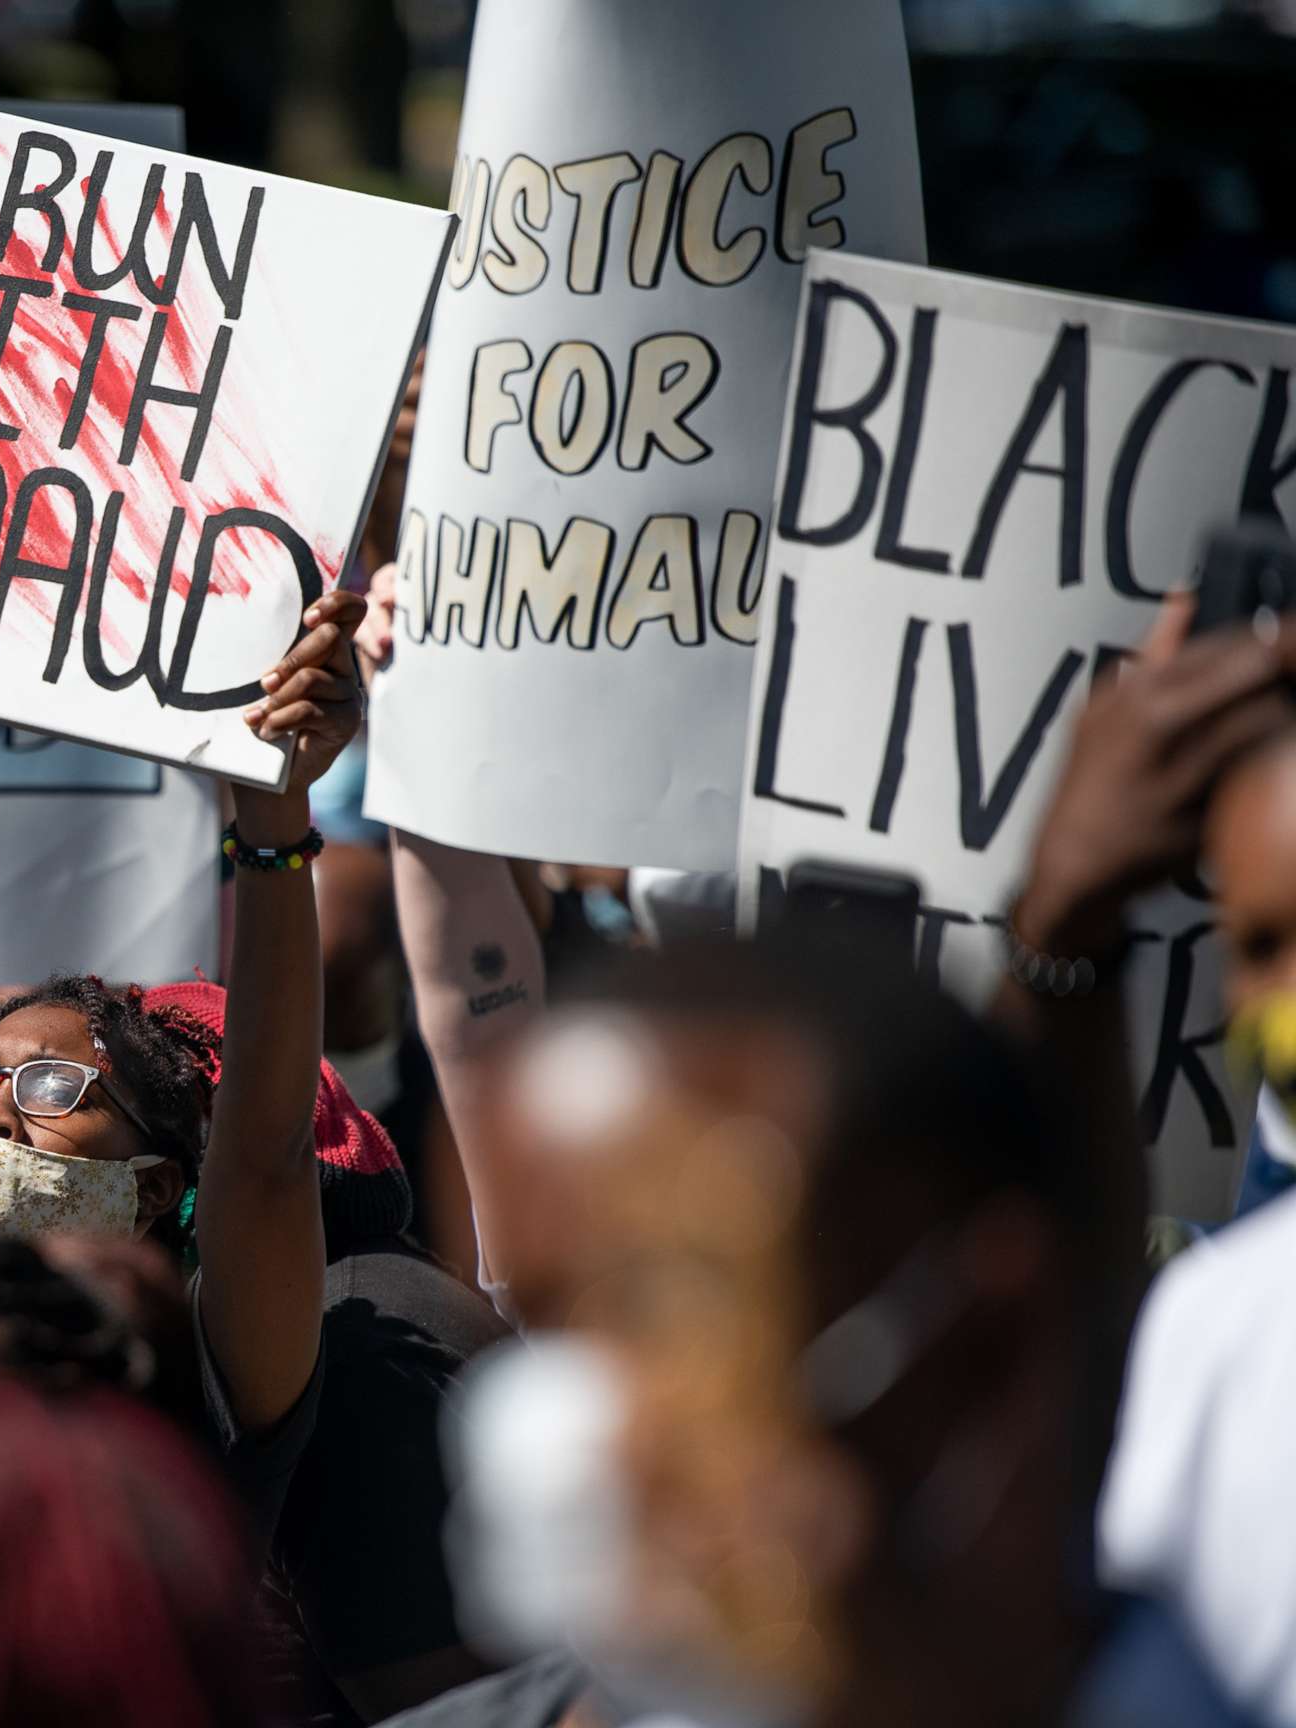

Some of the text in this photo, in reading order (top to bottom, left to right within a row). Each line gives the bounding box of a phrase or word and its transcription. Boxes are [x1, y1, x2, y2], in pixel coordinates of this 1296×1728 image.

[448, 107, 857, 295] USTICE
[464, 331, 720, 476] FOR
[396, 508, 766, 651] AHMAU
[753, 572, 1140, 852] LIV
